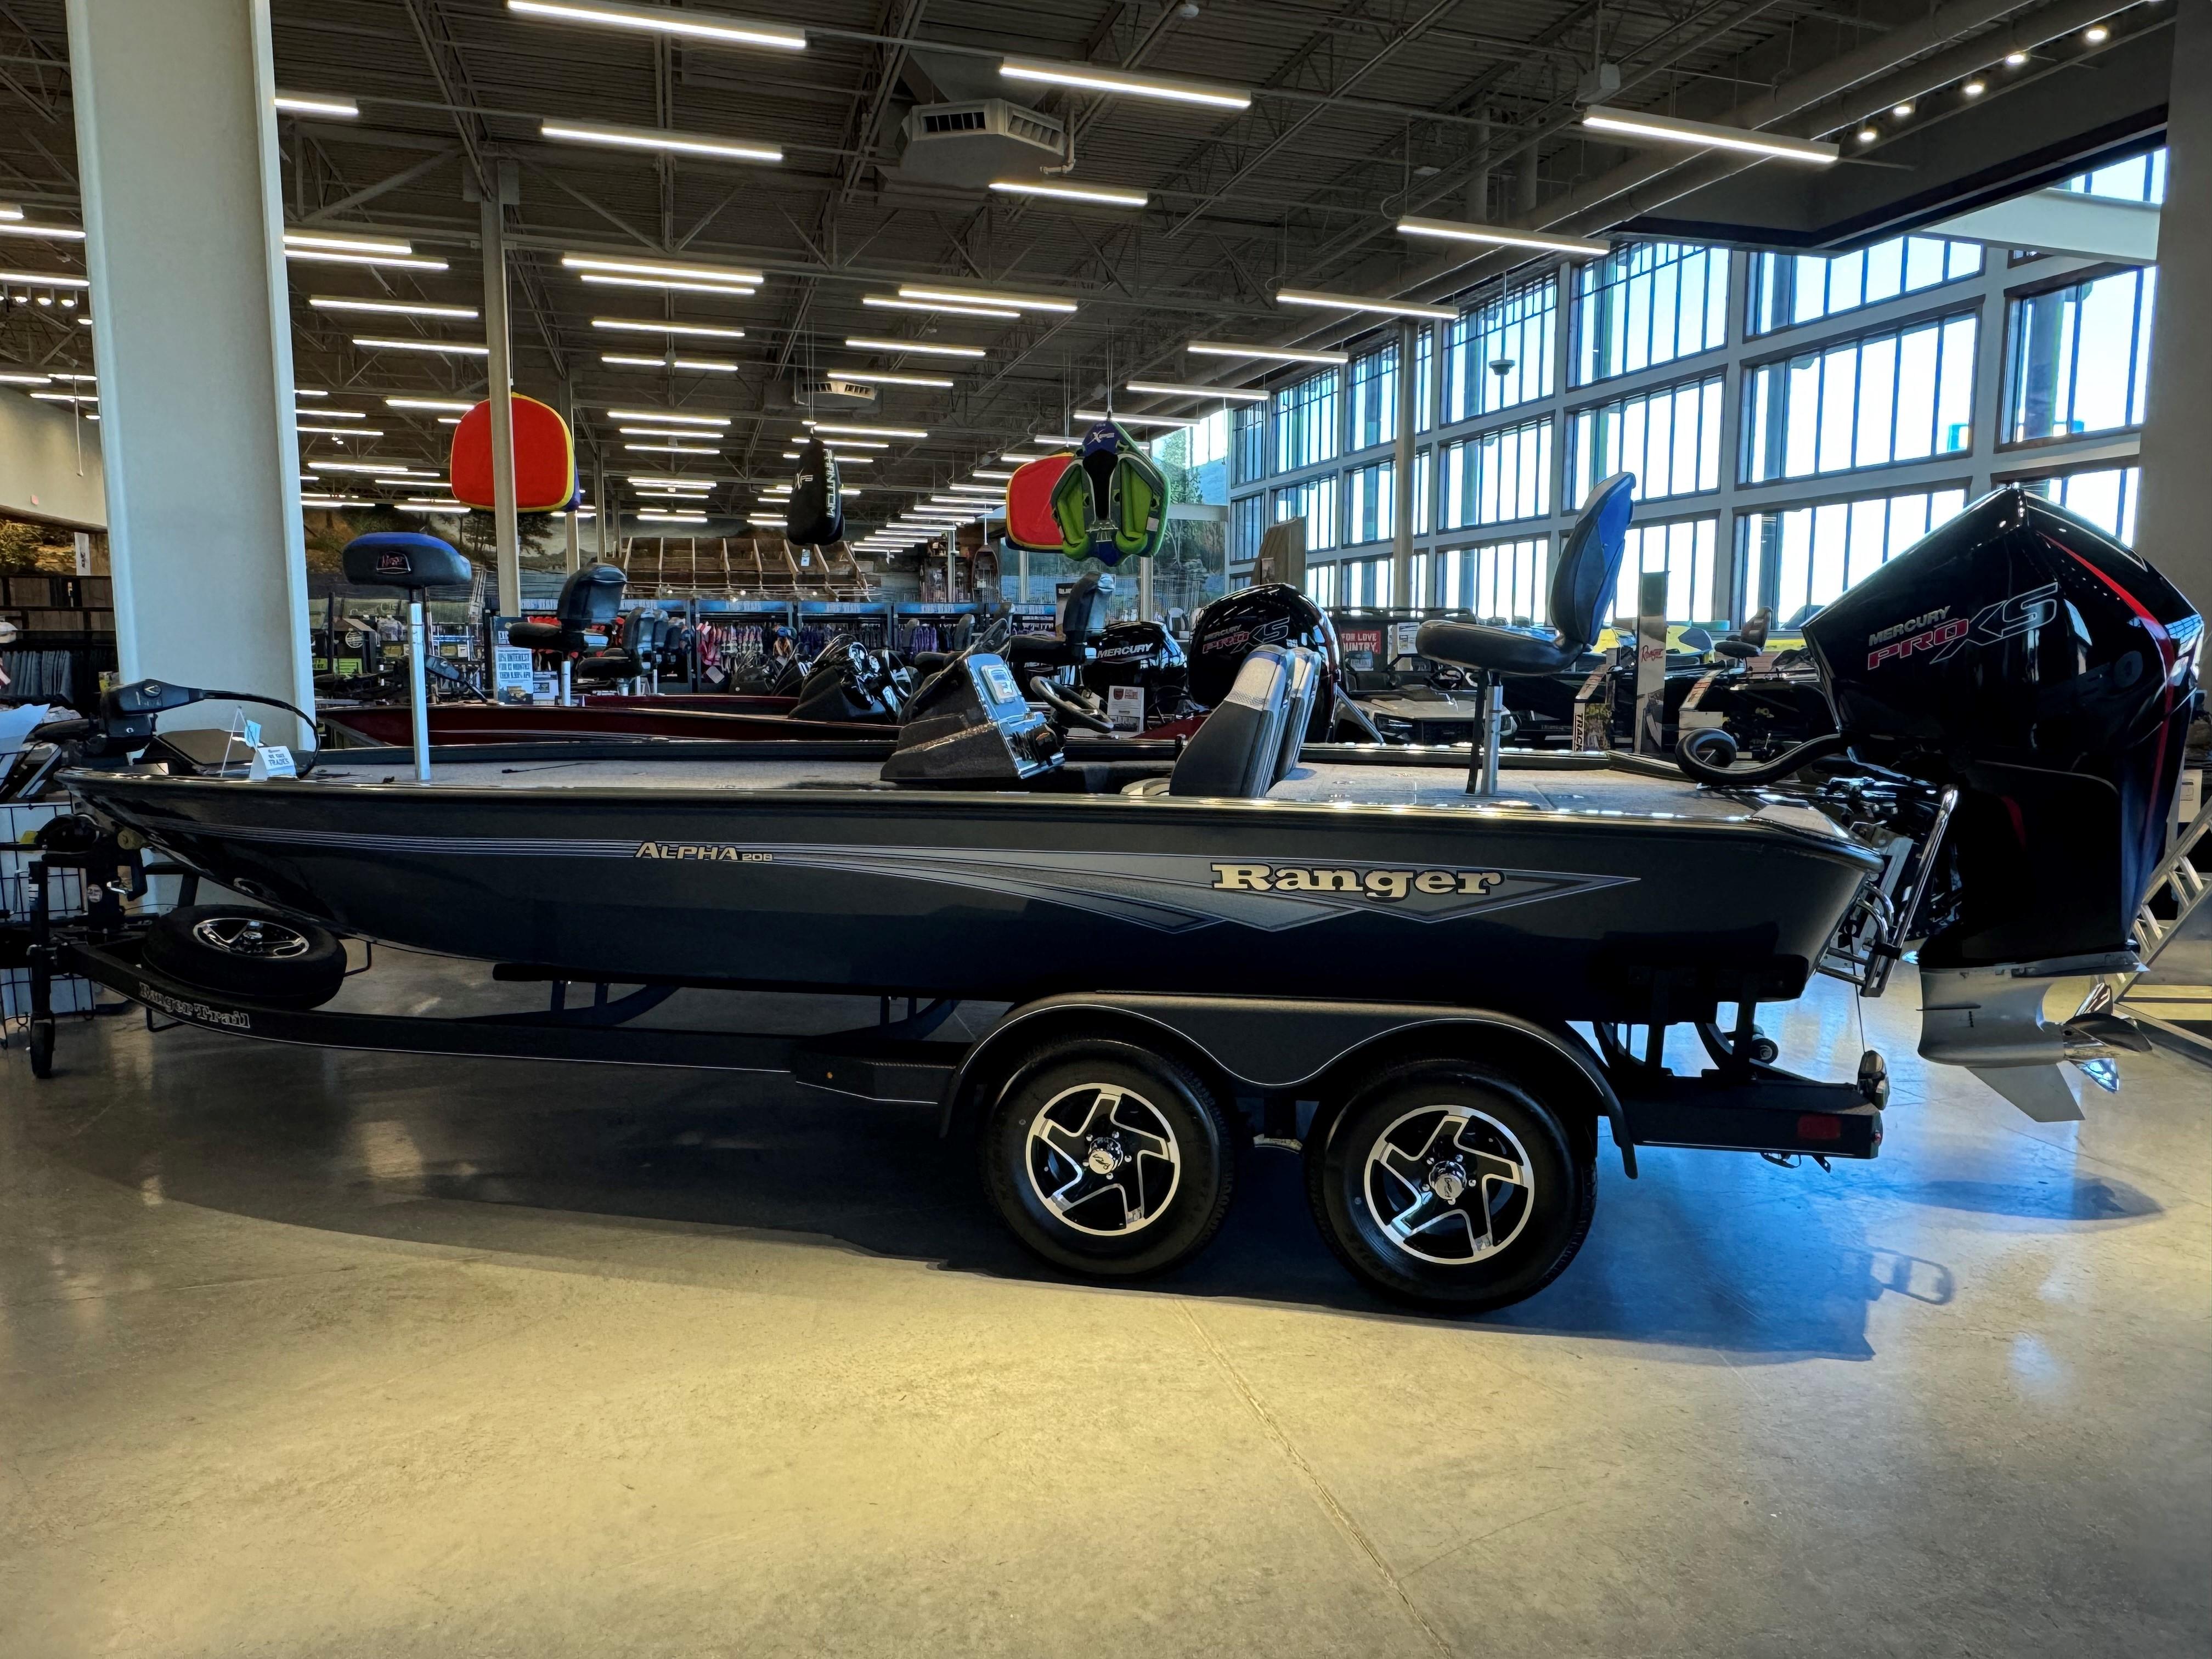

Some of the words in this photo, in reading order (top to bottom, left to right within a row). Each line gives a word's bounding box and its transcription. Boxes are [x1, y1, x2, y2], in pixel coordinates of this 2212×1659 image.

[1341, 633, 1356, 641] FOR
[1357, 633, 1377, 641] LOVE
[1868, 605, 1951, 646] MERCURY
[1097, 643, 1153, 658] MERCURY
[634, 842, 738, 861] ALPHA
[1210, 863, 1503, 900] Ranger
[139, 981, 193, 1016] Ranger
[193, 1003, 251, 1029] Trail
